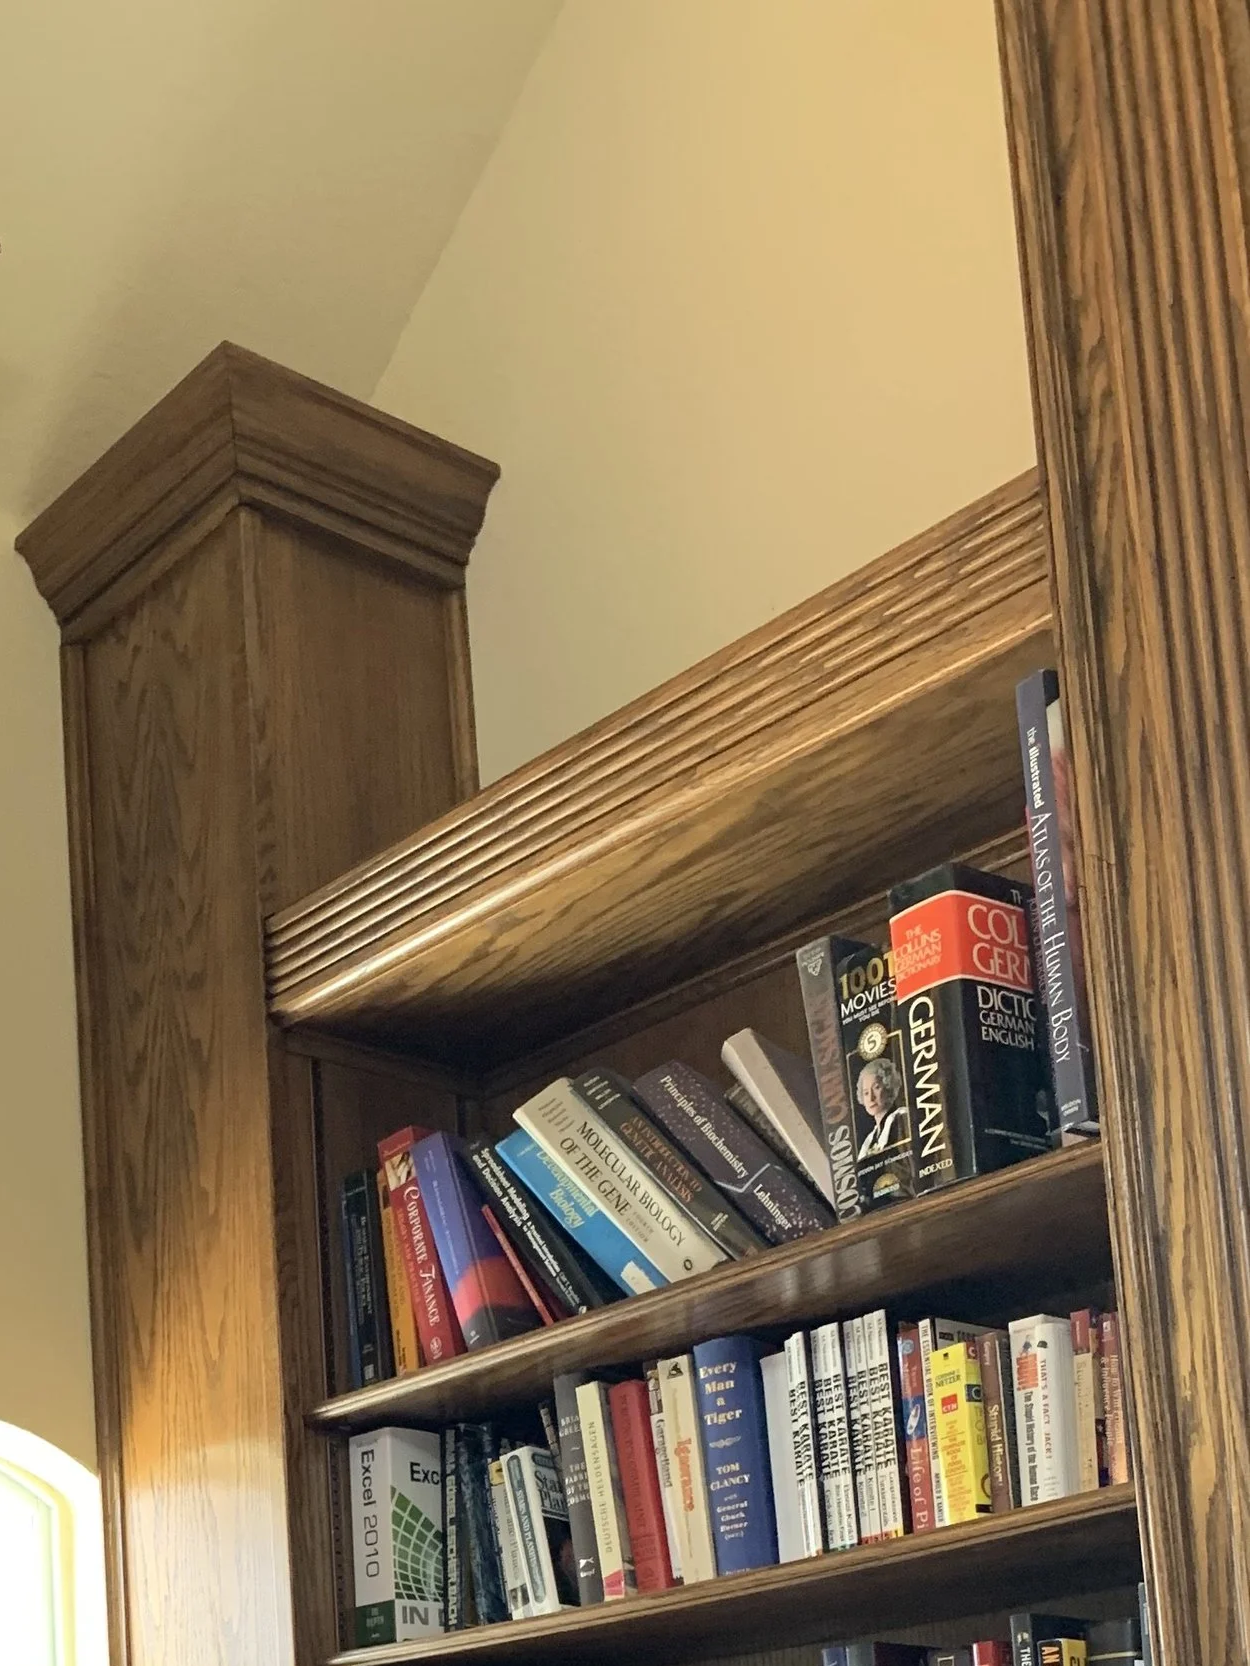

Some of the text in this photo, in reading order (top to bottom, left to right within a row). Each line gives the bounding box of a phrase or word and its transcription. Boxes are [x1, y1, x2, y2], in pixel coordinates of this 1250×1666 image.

[1026, 727, 1075, 1064] the illustrated ATLAS OF THE HUMAN BODY
[839, 950, 895, 1000] 1001
[840, 978, 897, 1018] MOVIES
[908, 996, 947, 1157] GERMAN
[560, 1136, 634, 1216] OF THE GENE
[577, 1121, 686, 1248] MOLECULAR BIOLOGY
[918, 1157, 954, 1179] INDEXED
[550, 1189, 585, 1229] Biology
[753, 1184, 792, 1231] Lehninger
[405, 1186, 441, 1326] CORPORATE FINANCE
[699, 1361, 738, 1380] Every
[704, 1379, 735, 1395] Man
[703, 1408, 743, 1426] Tiger
[857, 1370, 875, 1471] BEST KARATE
[879, 1363, 897, 1467] BEST KARATE
[710, 1474, 751, 1492] CLANCY
[716, 1462, 740, 1476] TOM
[910, 1446, 930, 1530] Life of Pi
[361, 1449, 381, 1579] Excel 2010
[1041, 1646, 1060, 1665] AN
